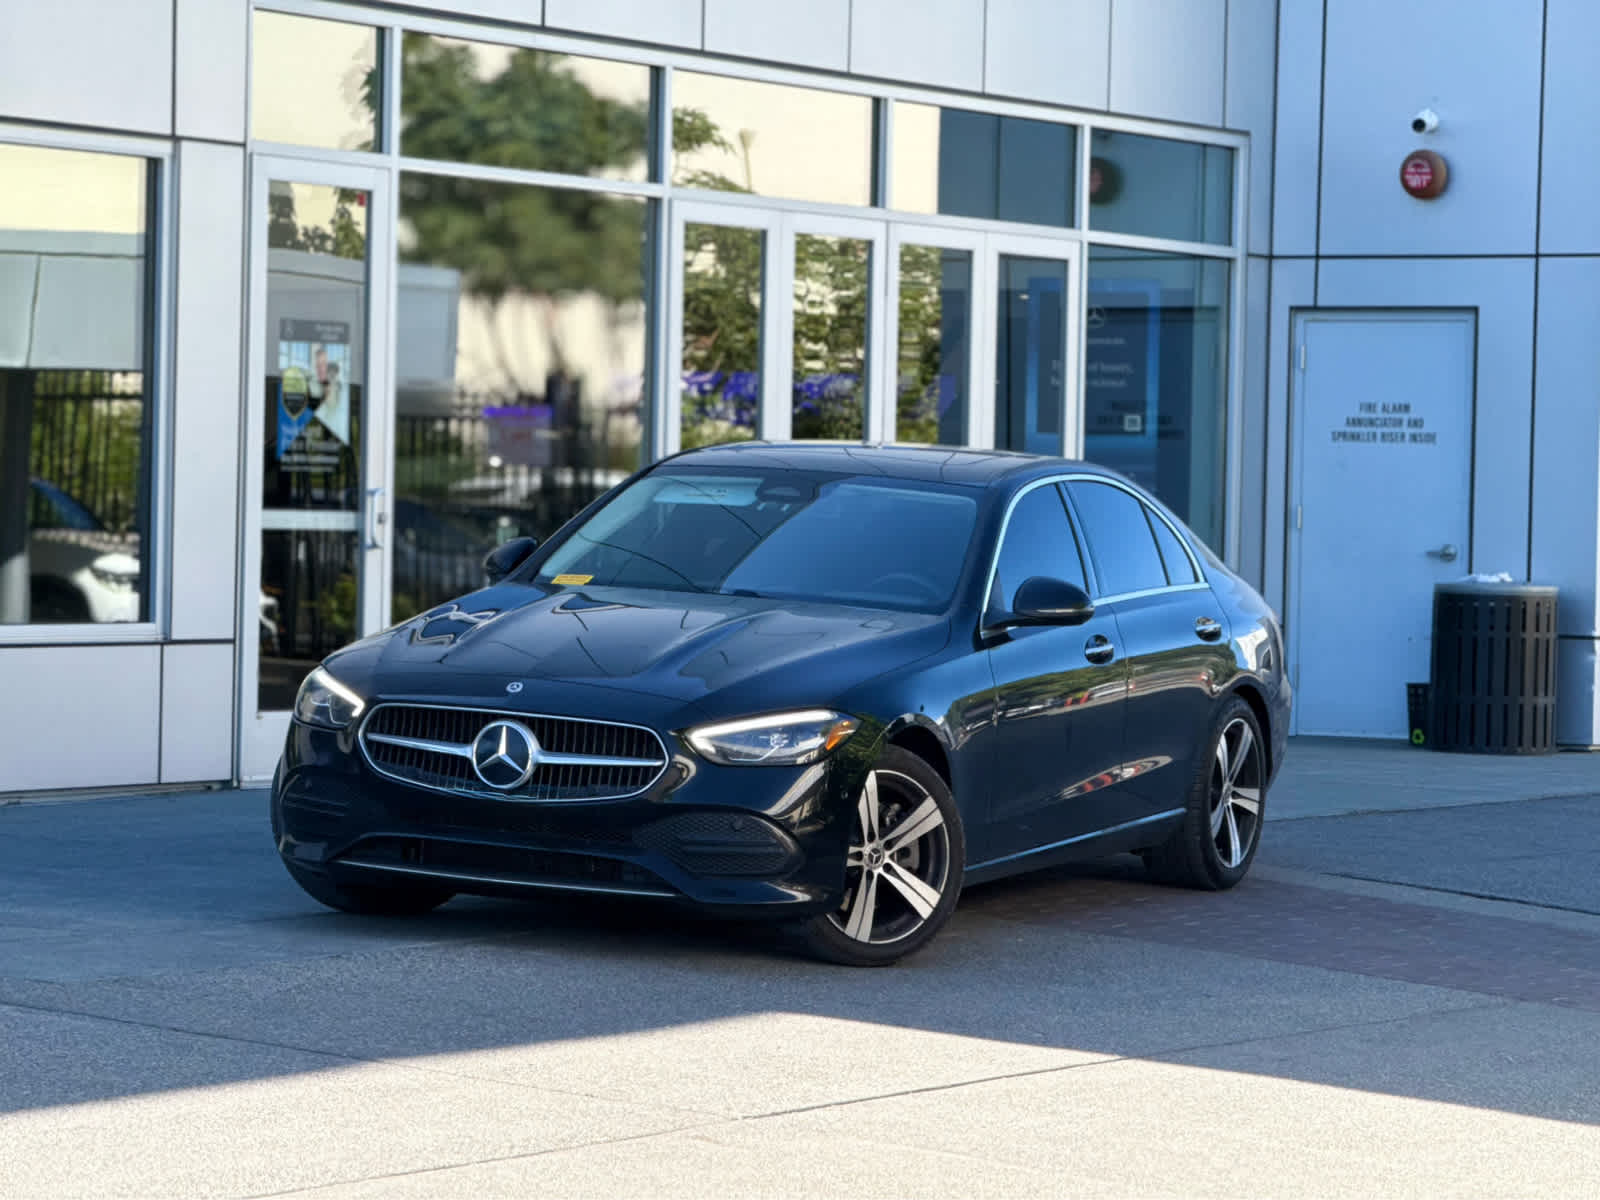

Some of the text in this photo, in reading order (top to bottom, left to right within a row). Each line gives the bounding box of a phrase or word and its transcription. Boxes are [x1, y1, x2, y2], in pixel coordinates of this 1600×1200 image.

[1359, 402, 1411, 414] FIRE ALARM
[1407, 417, 1424, 429] AND
